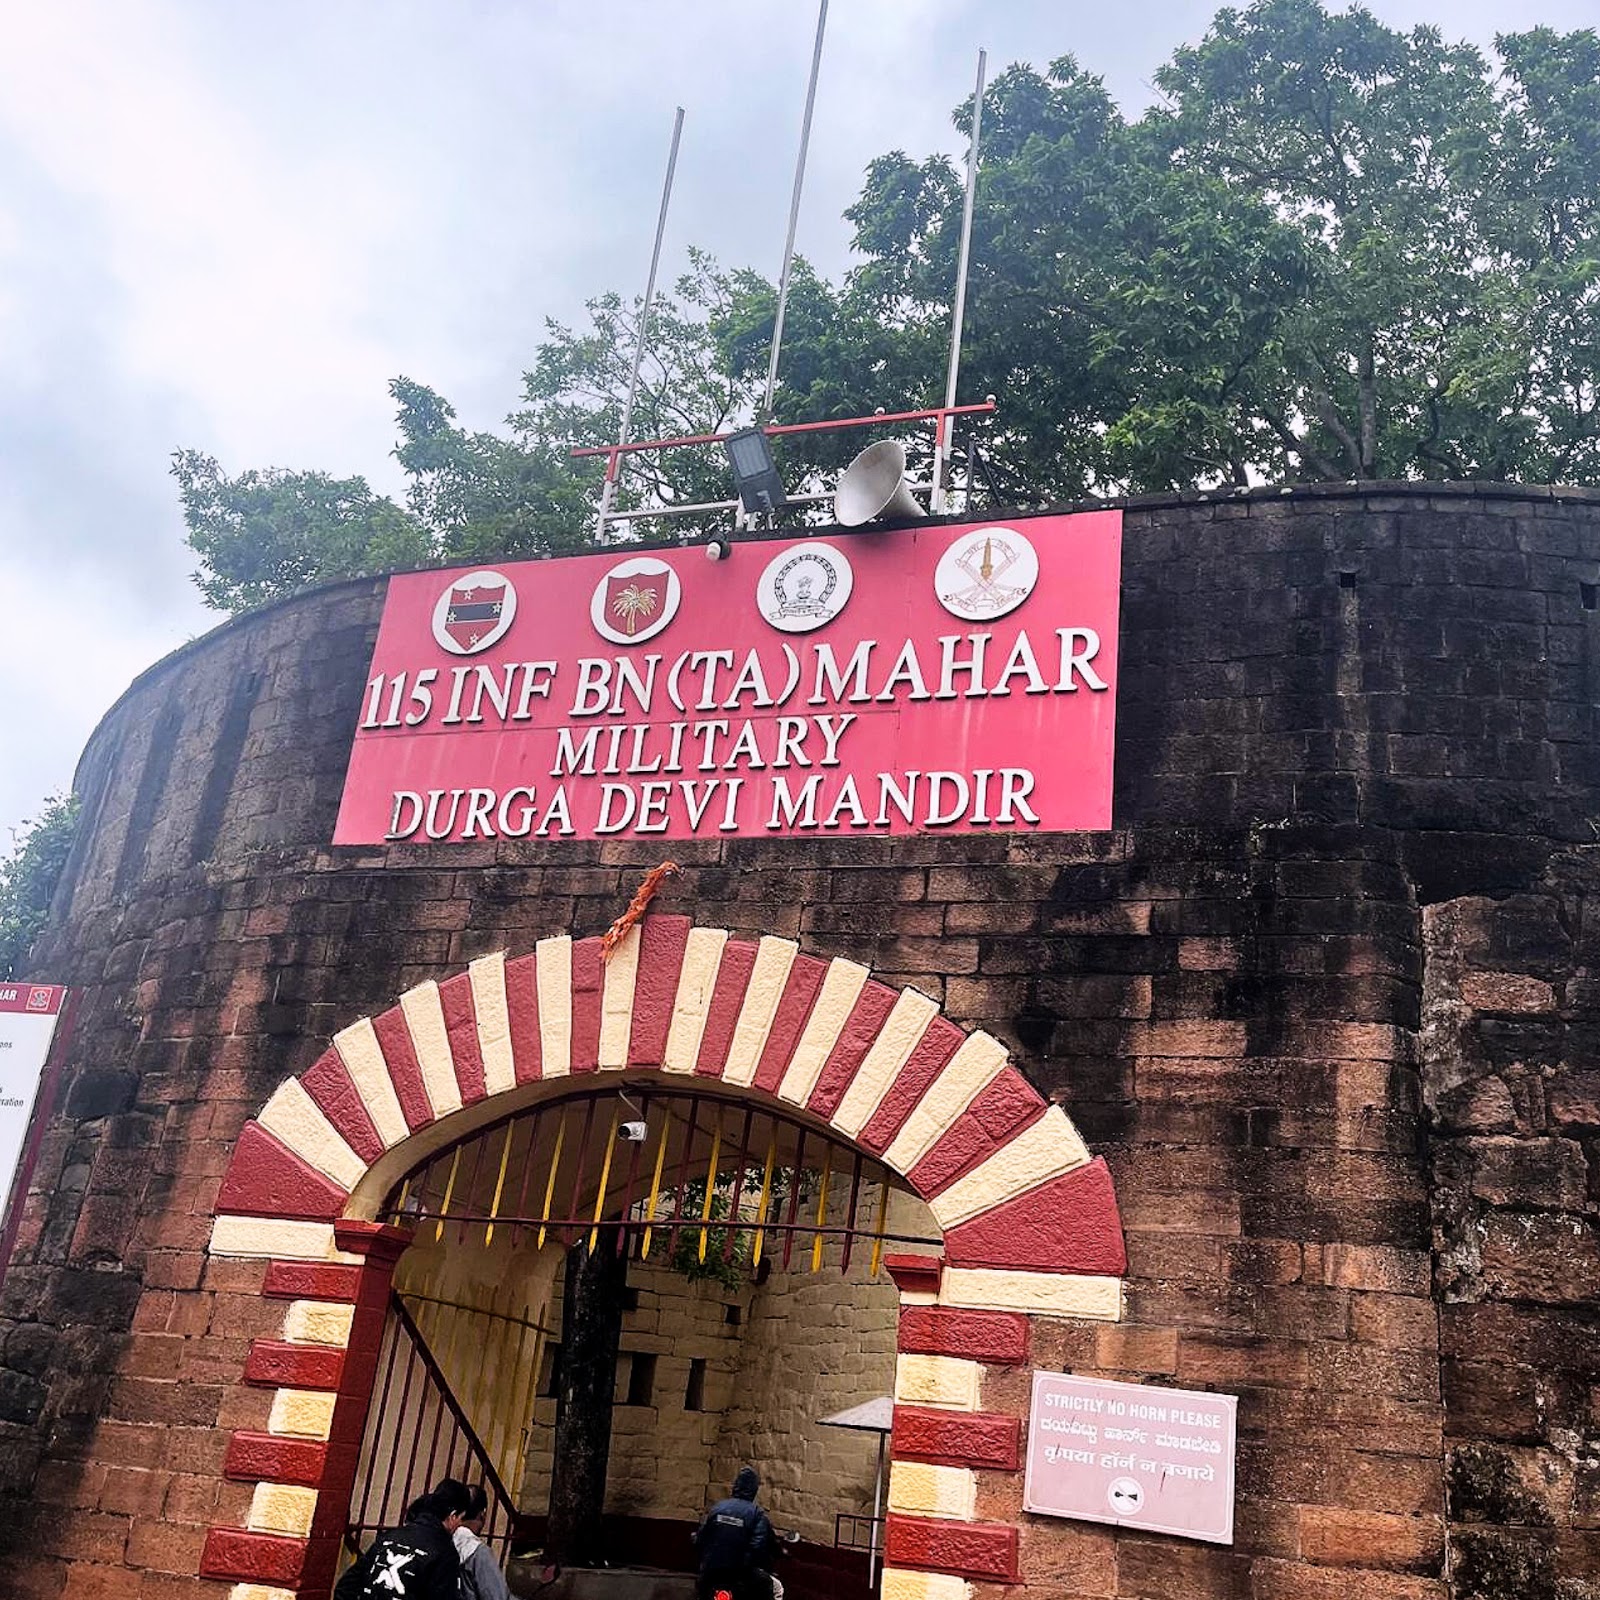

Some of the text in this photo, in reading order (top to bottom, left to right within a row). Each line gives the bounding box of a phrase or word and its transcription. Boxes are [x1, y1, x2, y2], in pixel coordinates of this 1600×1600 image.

[360, 627, 1109, 730] 115 INF BN (TA) MAHAR
[549, 713, 858, 776] MILITARY
[383, 766, 1041, 841] DURGA DEVI MANDIR
[1044, 1393, 1222, 1428] STRICTLY NO HORN PLEASE
[1044, 1445, 1095, 1464] कृपया
[1100, 1452, 1136, 1471] हॉर्न
[1140, 1459, 1156, 1474] न
